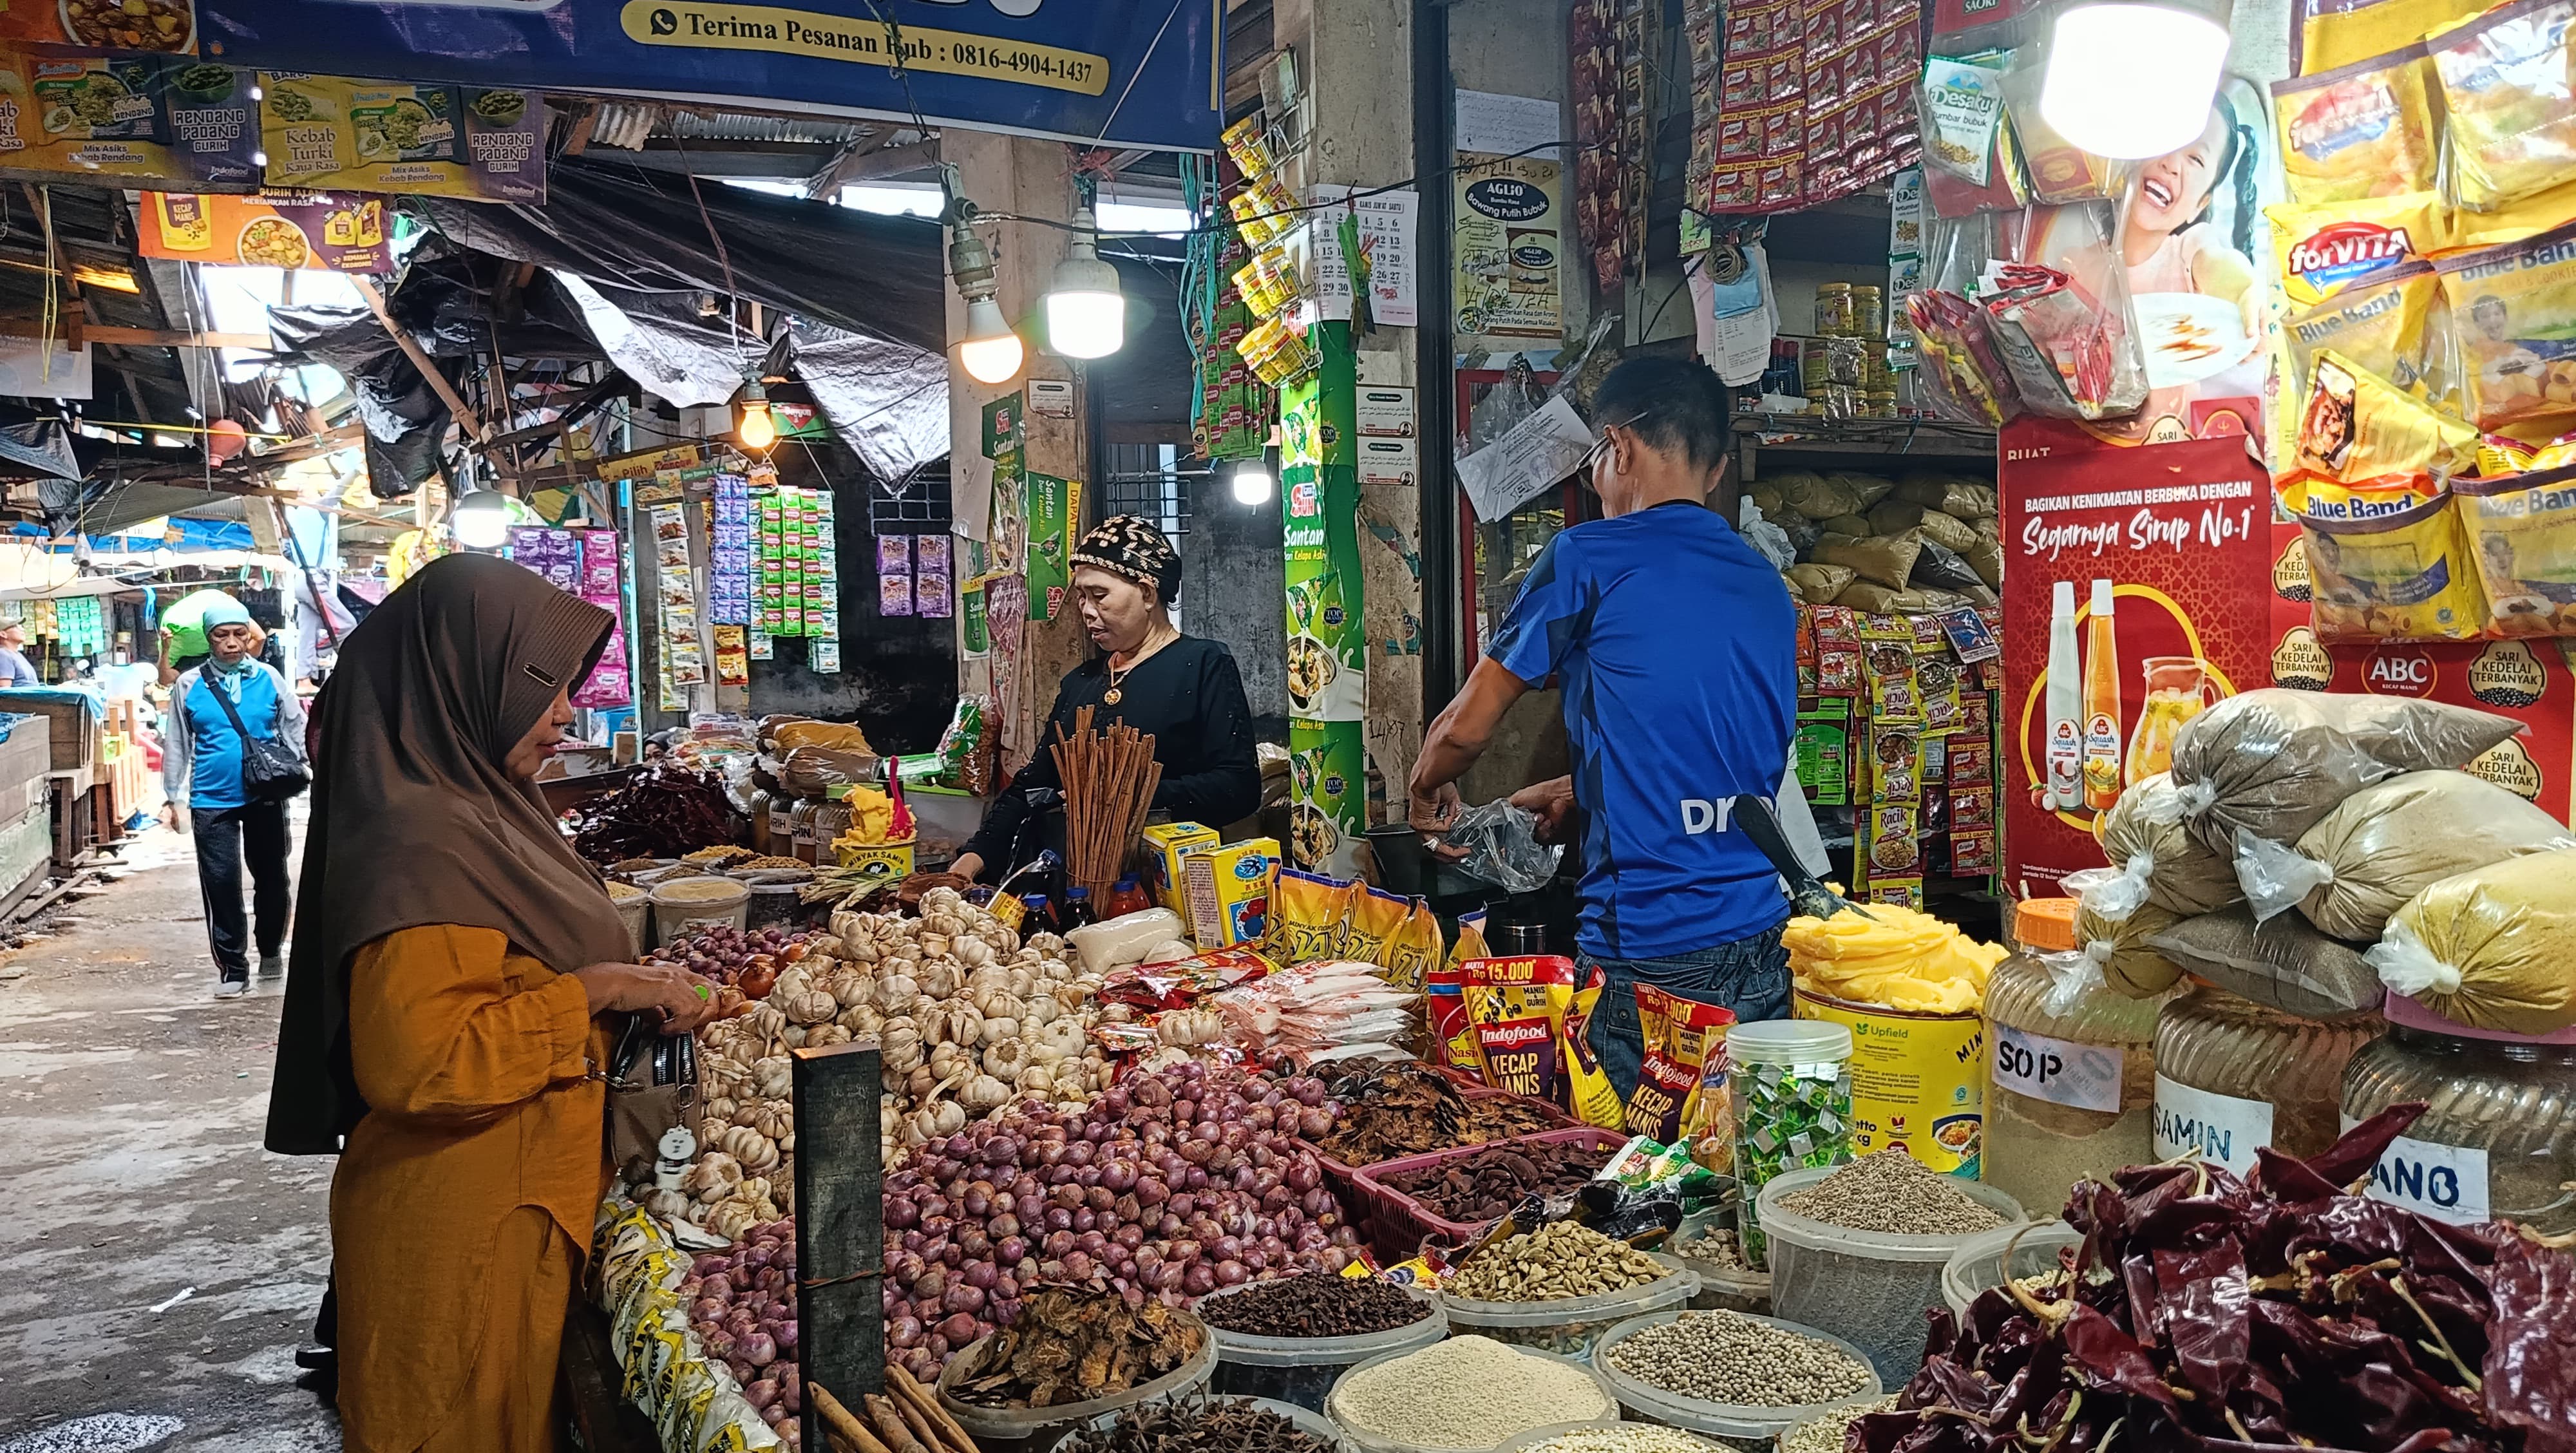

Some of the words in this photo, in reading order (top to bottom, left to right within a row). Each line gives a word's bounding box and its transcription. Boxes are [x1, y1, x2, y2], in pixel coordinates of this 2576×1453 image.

[686, 13, 779, 41] Terima
[785, 20, 877, 55] Pesanan
[884, 33, 932, 61] Hub
[952, 41, 1092, 83] 0816-4904-1437
[1929, 86, 1992, 116] Desaku
[1933, 111, 1961, 123] tumbar
[1963, 116, 1988, 128] bubuk
[286, 129, 336, 143] Kebab
[84, 144, 101, 153] Mix
[102, 144, 128, 153] Asiks
[194, 140, 229, 151] GURIH
[97, 153, 144, 162] Rendang
[291, 146, 333, 160] Turki
[285, 162, 314, 174] Kaya
[315, 162, 340, 171] Rasa
[489, 162, 519, 172] GURIH
[379, 174, 406, 182] Kebab
[407, 173, 444, 182] Rendang
[260, 188, 292, 197] GURIH
[173, 204, 193, 213] KECAP
[291, 198, 314, 207] RASA
[1467, 193, 1499, 217] Bawang
[1502, 208, 1522, 218] Putih
[1524, 201, 1548, 216] Bubuk
[174, 213, 195, 222] MANIS
[1338, 213, 1343, 221] 2
[1378, 218, 1383, 226] 5
[1392, 218, 1398, 227] 6
[1323, 229, 1330, 238] 8
[1376, 235, 1386, 244] 12
[1390, 236, 1400, 245] 13
[1322, 247, 1333, 256] 15
[1376, 252, 1387, 261] 19
[1390, 254, 1400, 263] 20
[2291, 229, 2414, 274] forVITA
[2521, 240, 2576, 269] Ban
[1322, 265, 1334, 274] 22
[1338, 265, 1347, 274] 23
[1376, 271, 1387, 279] 26
[1390, 272, 1400, 281] 27
[2536, 265, 2576, 285] COOKIE
[1323, 283, 1334, 292] 29
[1338, 283, 1349, 292] 30
[2297, 313, 2343, 344] Blue
[2341, 287, 2401, 324] Band
[2157, 432, 2177, 442] SARI
[994, 439, 1014, 457] Santan
[622, 466, 648, 478] Pilih
[1046, 480, 1056, 519] Santan
[2025, 498, 2070, 513] BAGIKAN
[2071, 491, 2143, 510] KENIKMATAN
[2144, 486, 2199, 504] BERBUKA
[2200, 480, 2252, 501] DENGAN
[2528, 488, 2576, 514] Ban
[2308, 497, 2346, 519] Blue
[2351, 494, 2412, 518] Band
[1284, 525, 1324, 547] Santan
[2023, 515, 2119, 562] Segarnya
[2128, 507, 2191, 553] Sirup
[1294, 550, 1312, 562] Kelapa
[1312, 550, 1325, 560] Asli
[2292, 643, 2312, 652] SARI
[2281, 652, 2322, 663] KEDELAI
[2494, 651, 2519, 662] SARI
[2275, 662, 2330, 674] TERBANYAK
[2370, 657, 2428, 683] ABC
[2481, 662, 2532, 674] KEDELAI
[2474, 672, 2541, 685] TERBANYAK
[1296, 720, 1314, 731] Kelapa
[2052, 736, 2076, 748] Squash
[2088, 733, 2116, 746] Squash
[2490, 752, 2514, 763] SARI
[2477, 761, 2527, 775] KEDELAI
[1880, 808, 1907, 828] Racik
[848, 851, 879, 868] MINYAK
[880, 851, 905, 866] SAMIN
[1289, 920, 1317, 932] MINYAK
[1464, 961, 1484, 970] HANYA
[1473, 969, 1486, 980] Rp
[1523, 986, 1546, 995] MANIS
[1637, 984, 1657, 996] HANYA
[1526, 998, 1546, 1007] GURIH
[1647, 994, 1660, 1007] Rp
[1481, 1023, 1548, 1045] Indofood
[1679, 1031, 1701, 1043] MANIS
[1871, 1026, 1909, 1040] Upfield
[1491, 1052, 1539, 1076] KECAP
[1999, 1039, 2062, 1084] SOP
[1643, 1054, 1696, 1088] Indofood
[1631, 1083, 1674, 1115] KECAP
[1625, 1103, 1663, 1141] MANIS
[2154, 1100, 2231, 1162] SAMIN
